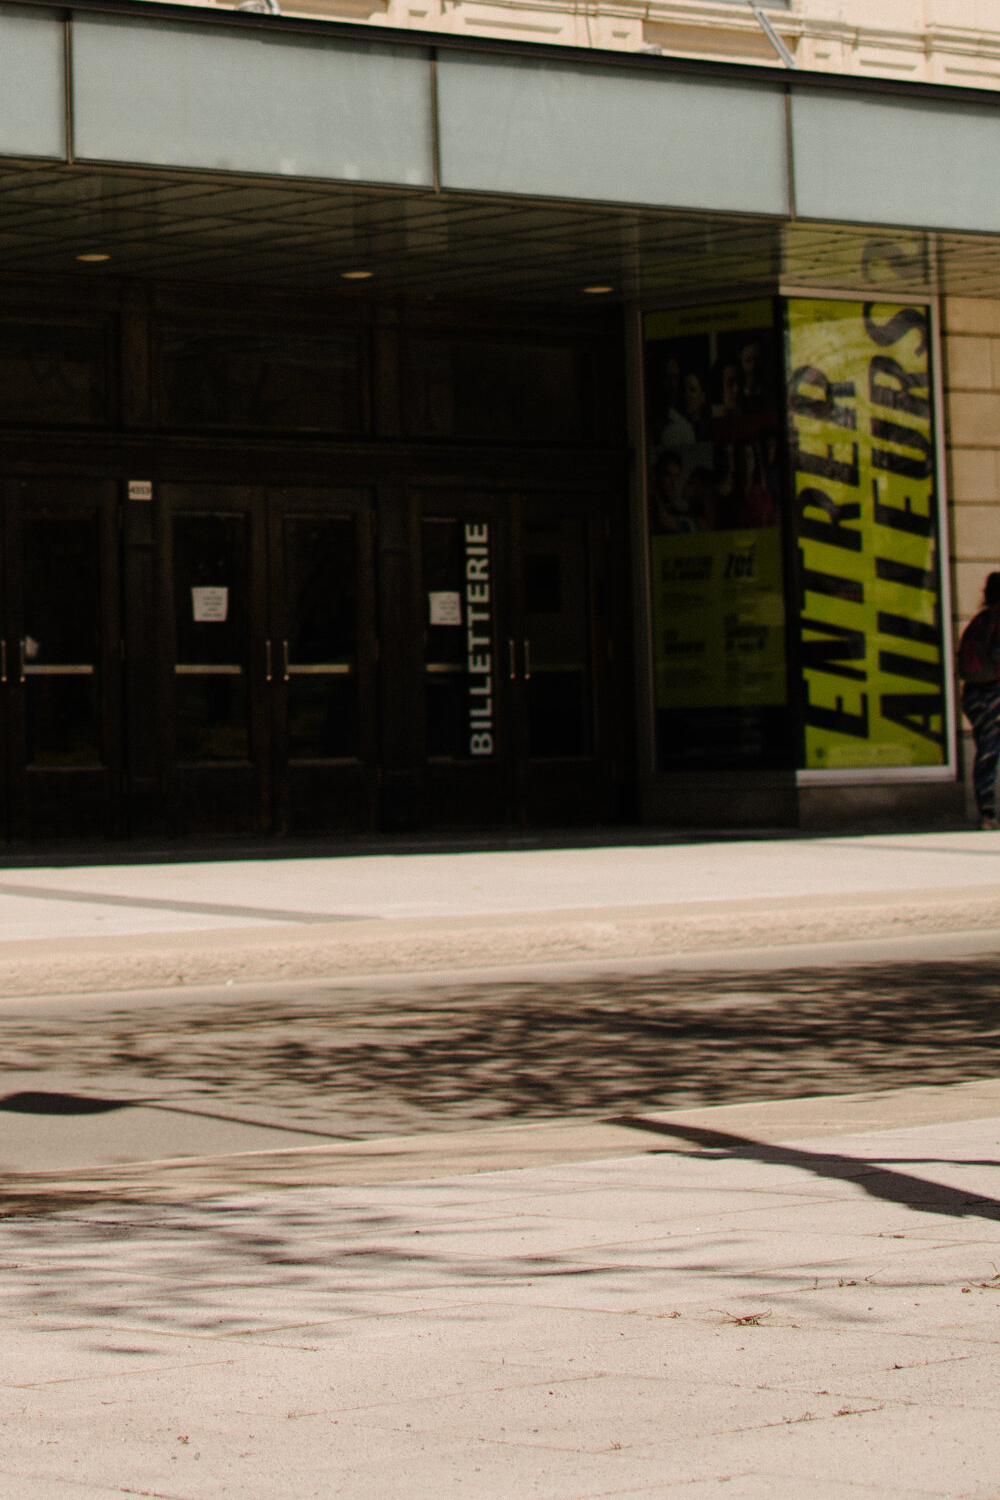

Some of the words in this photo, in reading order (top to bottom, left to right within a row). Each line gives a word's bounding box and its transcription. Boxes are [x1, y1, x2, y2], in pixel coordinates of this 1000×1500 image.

[465, 523, 493, 756] BILLETTERIE
[787, 364, 870, 740] ENTRER
[862, 301, 947, 751] AILLEURS
